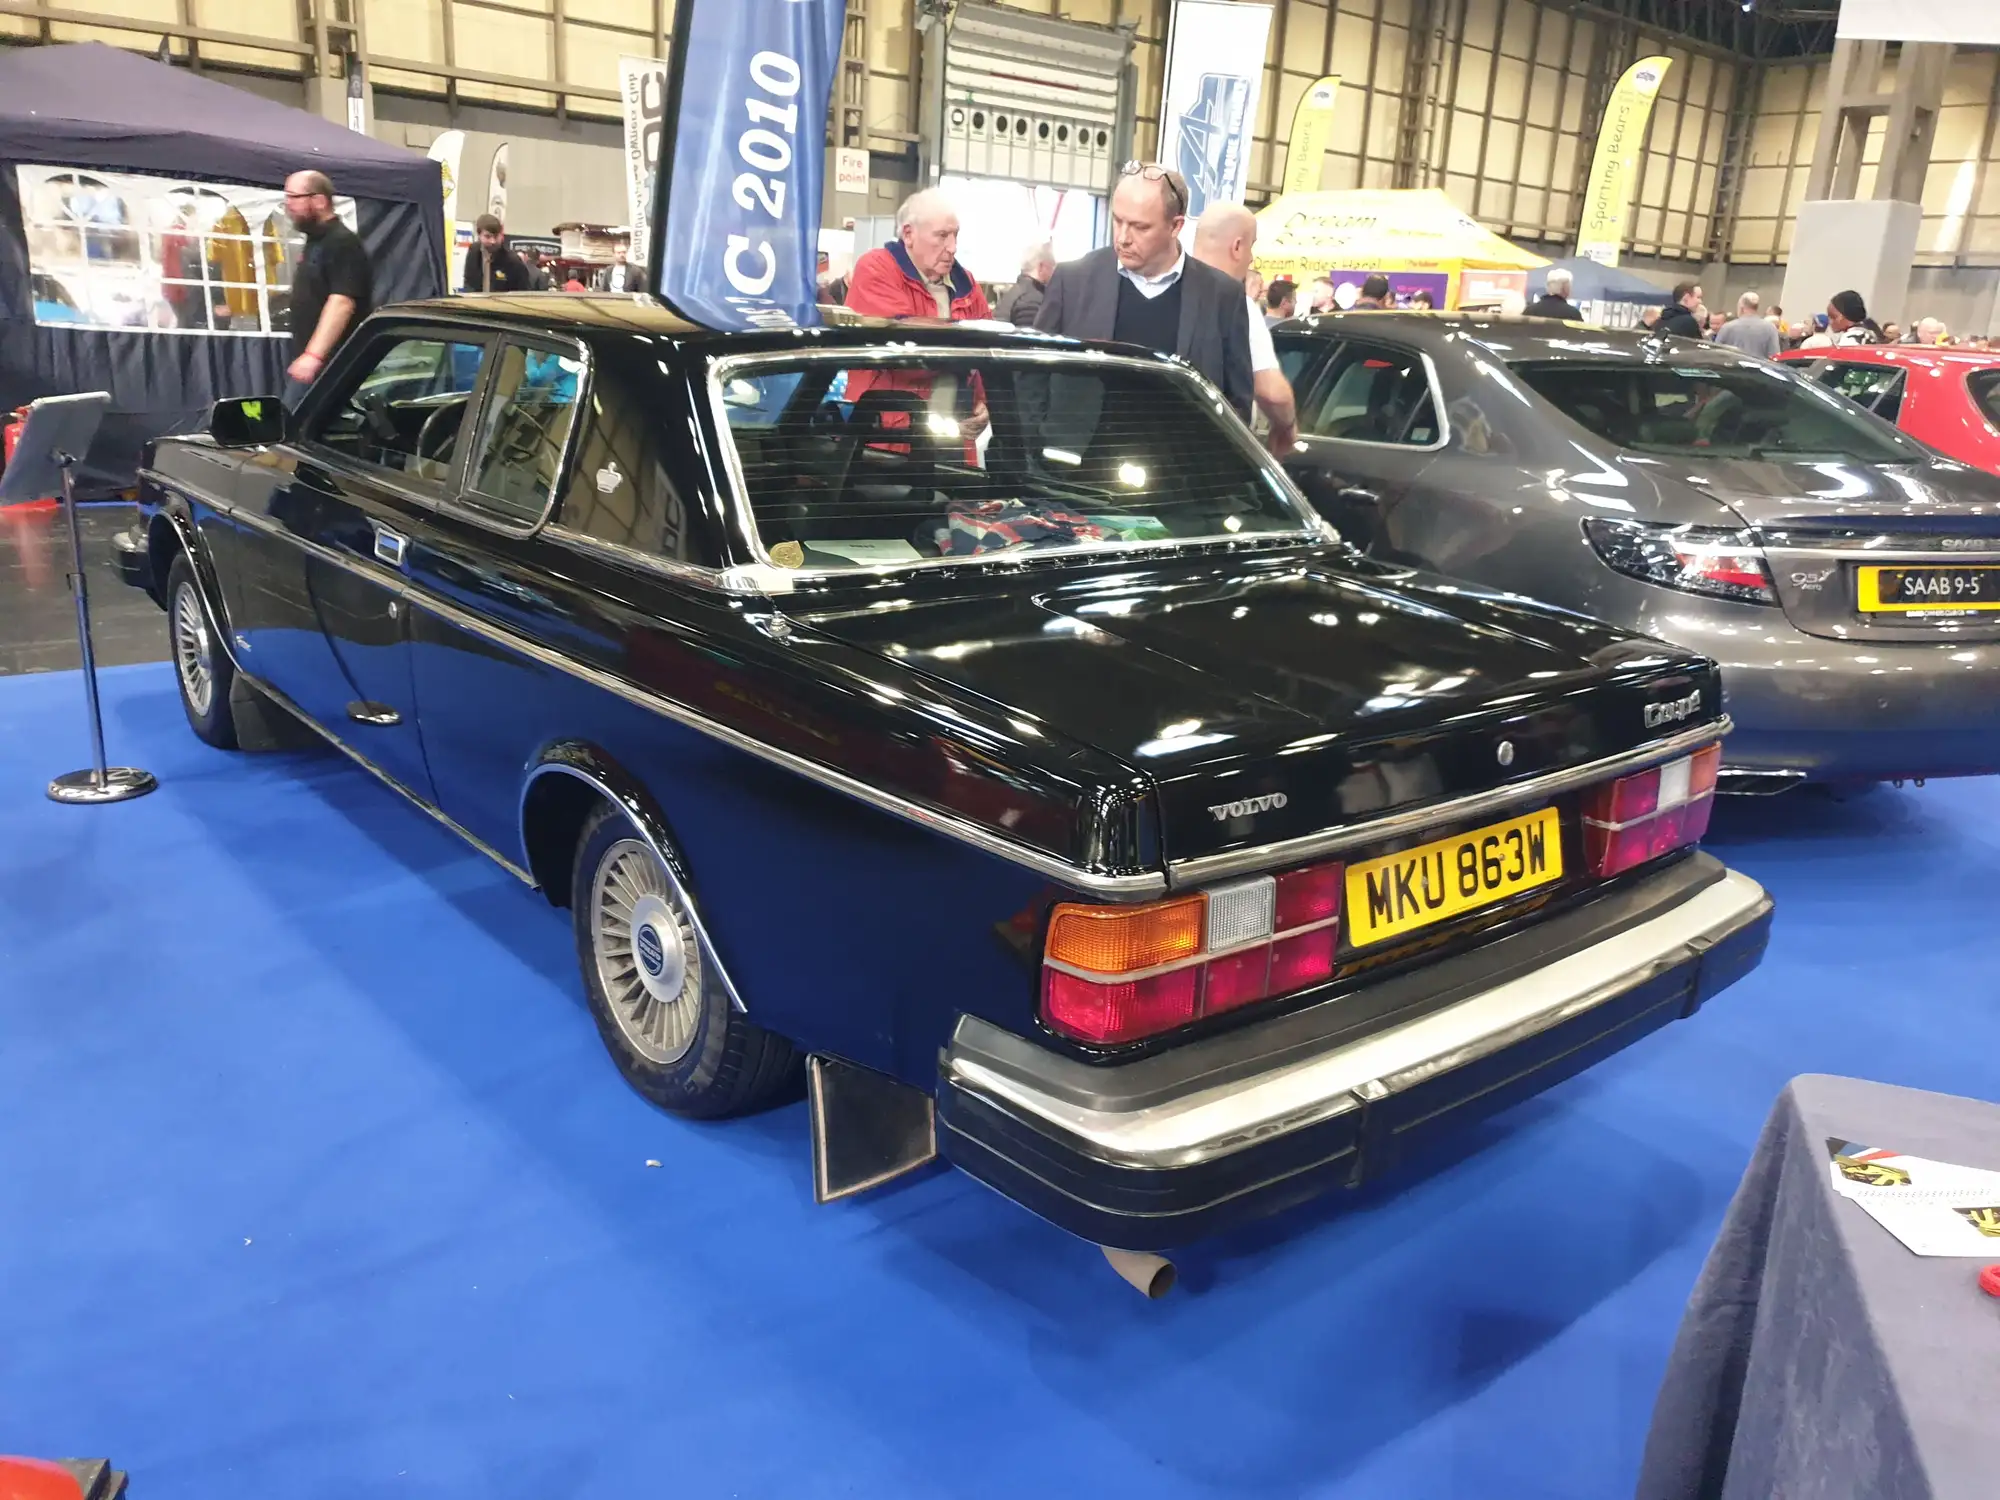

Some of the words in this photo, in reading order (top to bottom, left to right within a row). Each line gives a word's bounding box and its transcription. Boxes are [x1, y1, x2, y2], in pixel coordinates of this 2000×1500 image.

[732, 50, 800, 219] 2010
[842, 155, 863, 168] Fire
[1590, 160, 1620, 231] Sporting
[1607, 105, 1630, 154] Bears
[839, 173, 866, 185] point
[1253, 256, 1295, 270] Dream
[1300, 256, 1337, 272] Rides
[1904, 576, 1951, 595] SAAB
[1954, 576, 1981, 595] 9-5
[1208, 792, 1288, 821] VOLVO
[1366, 851, 1445, 929] MKU
[1457, 820, 1546, 897] 863W
